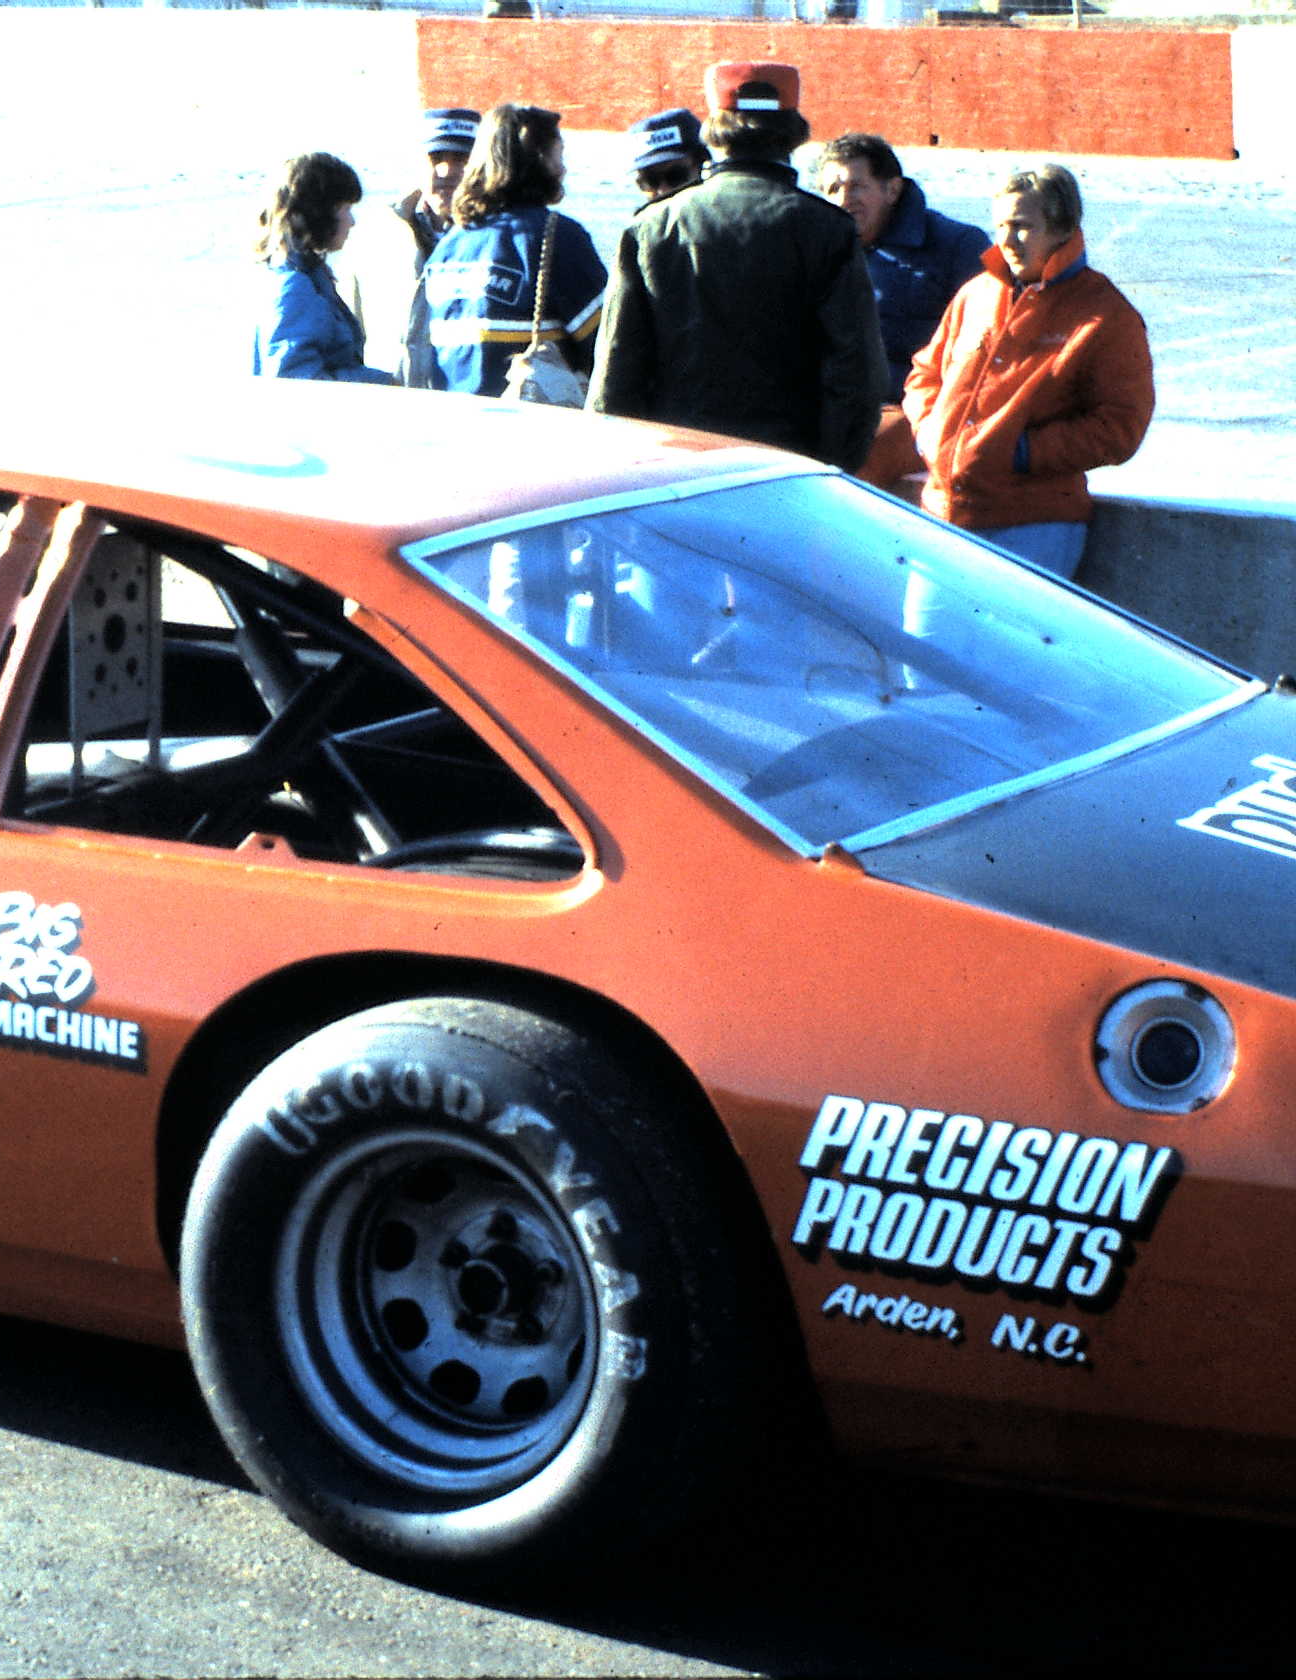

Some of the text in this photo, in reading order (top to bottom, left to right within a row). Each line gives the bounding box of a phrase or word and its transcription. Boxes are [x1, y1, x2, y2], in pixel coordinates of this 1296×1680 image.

[798, 1094, 1174, 1222] PRECISION
[791, 1176, 1123, 1297] PRODUCTS
[821, 1283, 1088, 1362] Arden, N.C.
